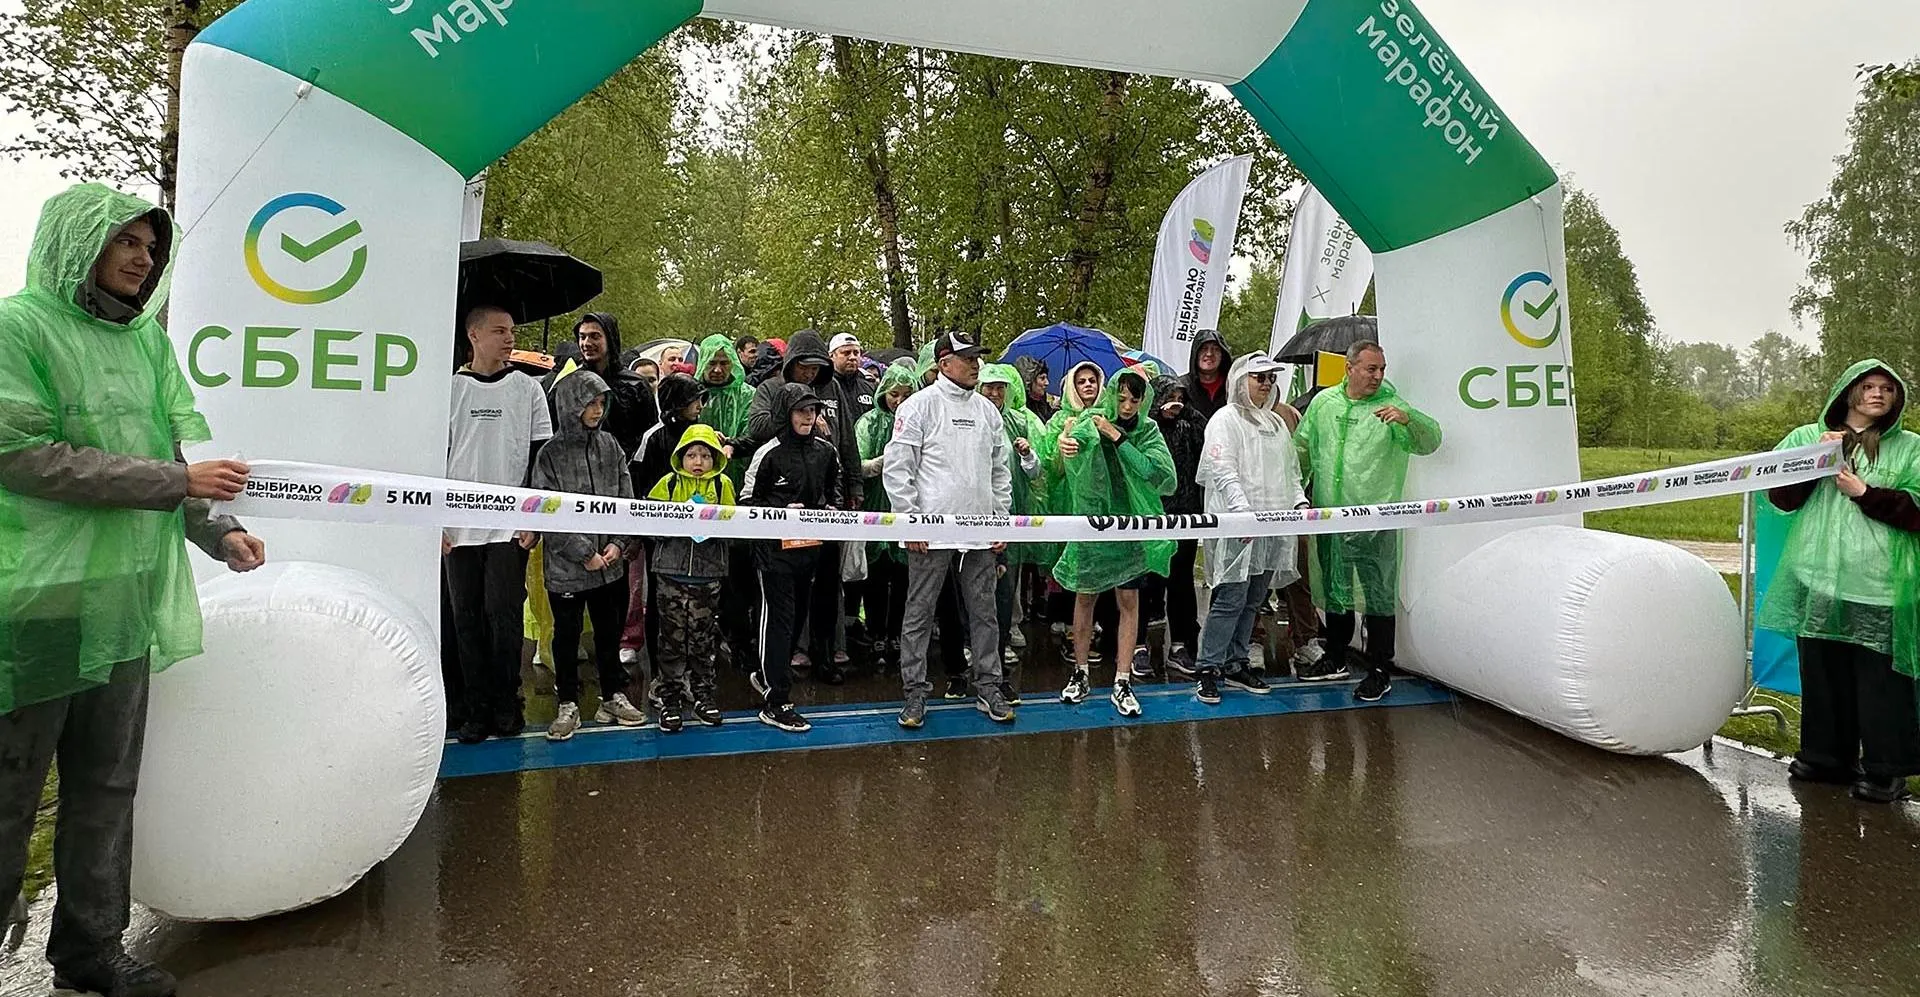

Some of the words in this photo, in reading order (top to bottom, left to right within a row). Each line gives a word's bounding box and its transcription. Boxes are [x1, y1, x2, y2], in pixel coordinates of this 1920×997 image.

[1380, 0, 1500, 141] зелёный
[1356, 15, 1483, 166] марафон
[1320, 215, 1345, 266] зелён
[1195, 269, 1207, 304] ВОЗДУХ
[1176, 267, 1199, 341] ВЫБИРАЮ
[187, 325, 418, 392] СБЕР
[1756, 466, 1763, 476] 5
[246, 481, 323, 494] ВЫБИРАЮ
[1665, 478, 1672, 488] 5
[286, 494, 322, 502] ВОЗДУХ
[386, 490, 398, 503] 5
[402, 491, 432, 506] КМ
[446, 492, 516, 505] ВЫБИРАЮ
[1566, 489, 1573, 499] 5
[446, 502, 481, 510] ЧИСТЫЙ
[482, 504, 516, 512] ВОЗДУХ
[575, 501, 585, 513] 5
[590, 501, 617, 514] КМ
[630, 502, 695, 513] ВЫБИРАЮ
[1457, 499, 1466, 510] 5
[749, 508, 758, 519] 5
[763, 509, 787, 520] КМ
[1341, 508, 1350, 517] 5
